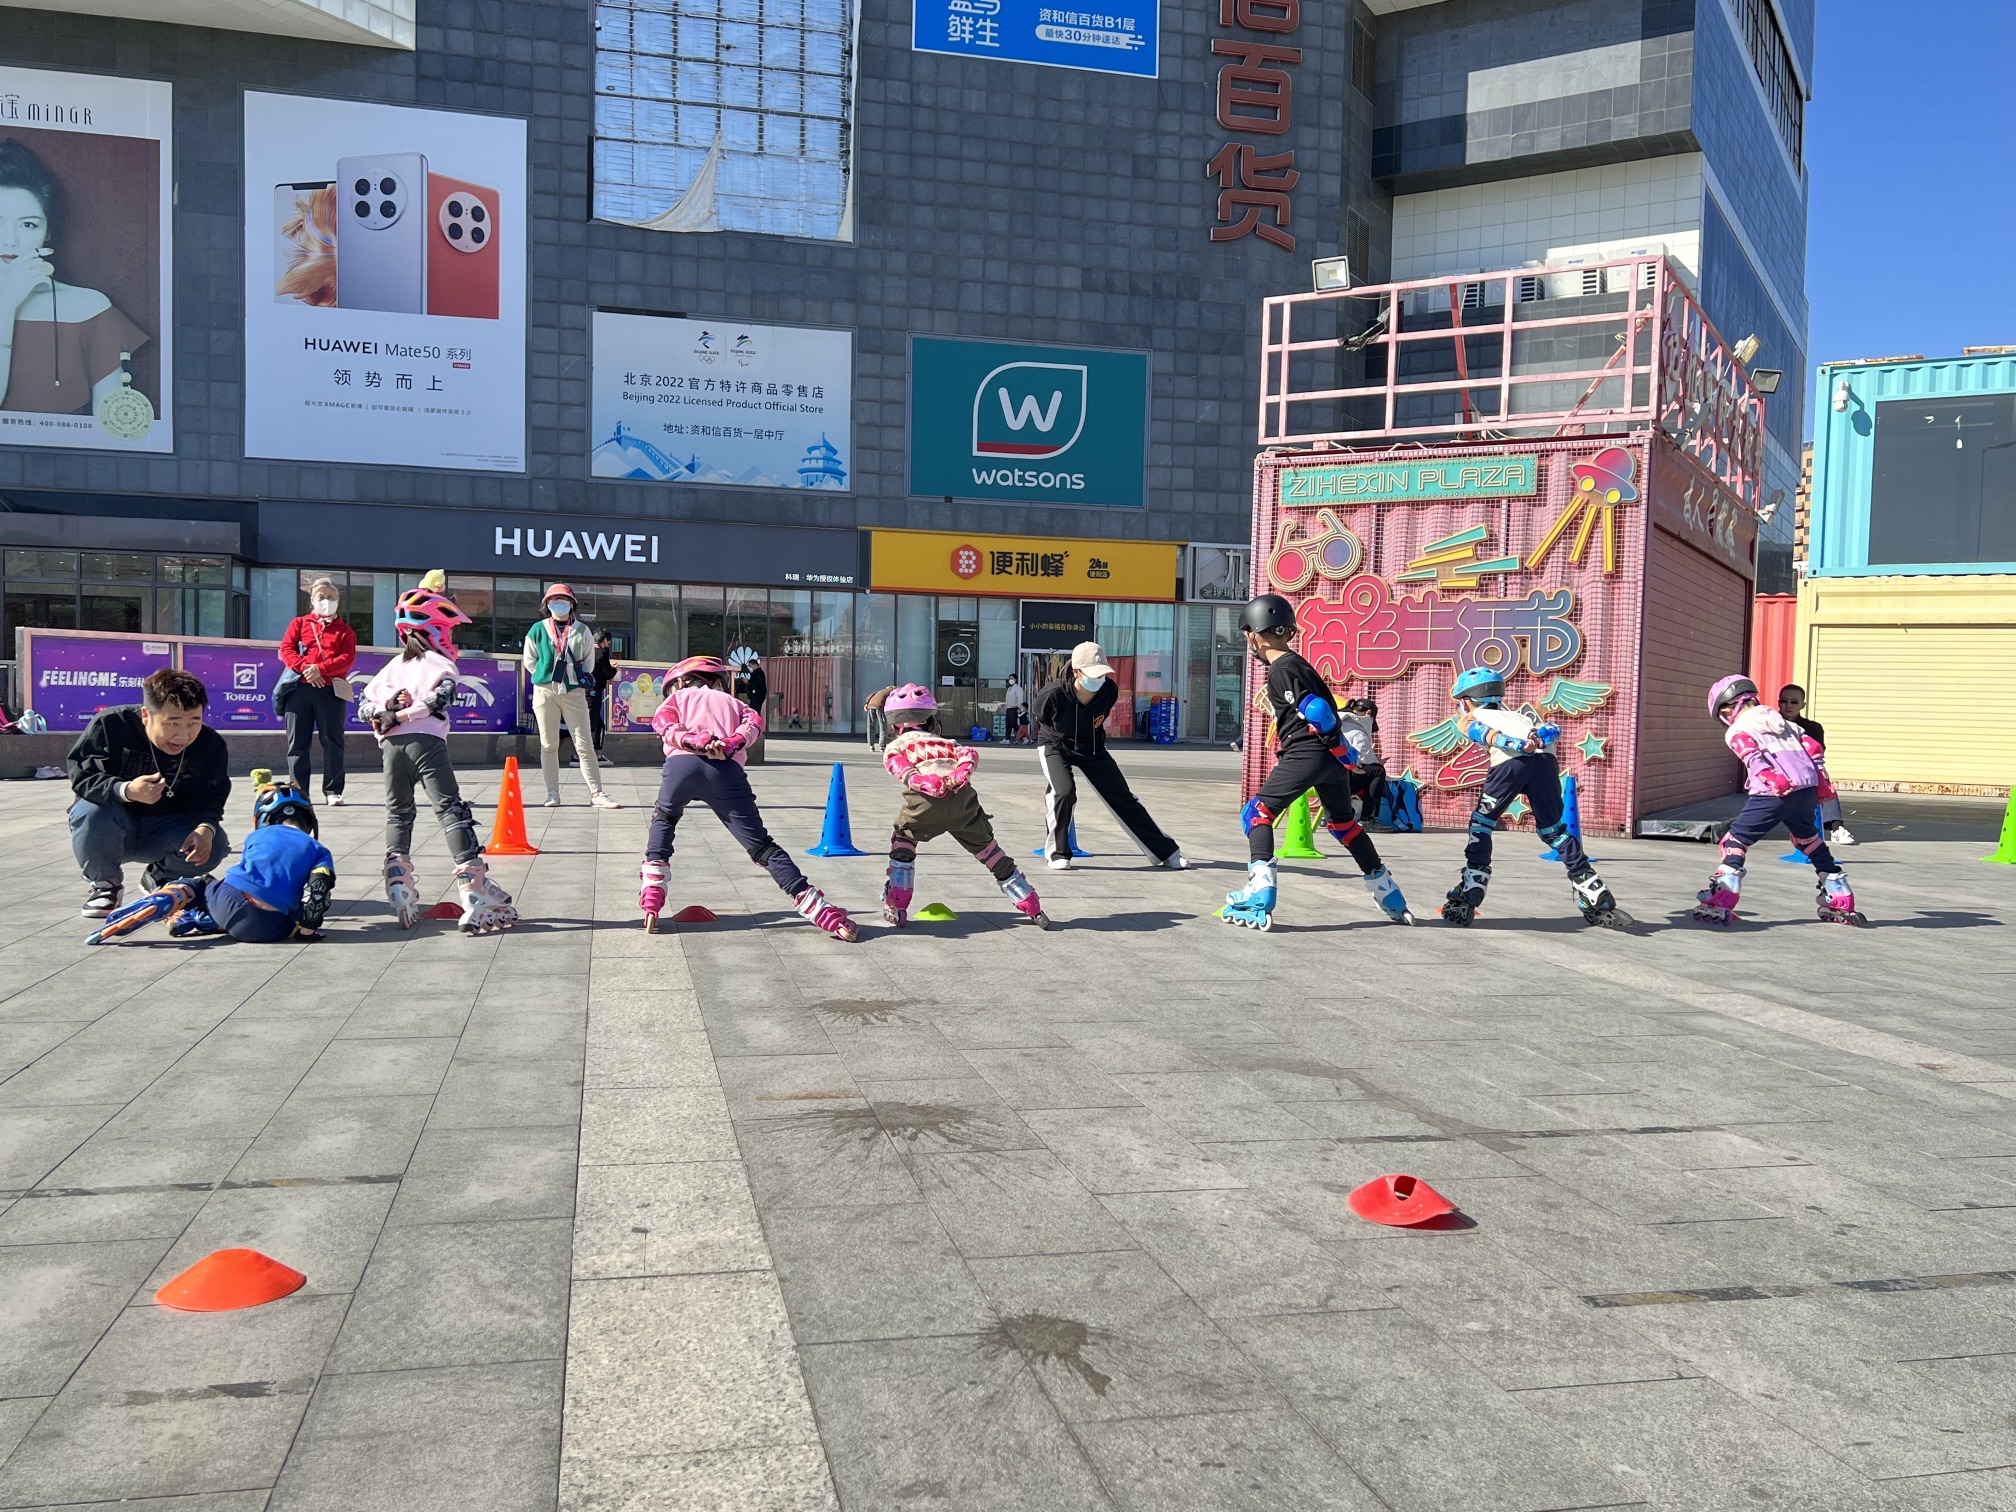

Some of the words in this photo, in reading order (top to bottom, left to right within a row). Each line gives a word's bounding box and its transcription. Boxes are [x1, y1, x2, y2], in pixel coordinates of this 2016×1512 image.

[947, 14, 1000, 47] 鲜生
[1039, 8, 1136, 31] 资和信百货B1层
[1045, 29, 1121, 46] 最快30分钟送达
[304, 337, 378, 355] HUAWEI
[385, 343, 441, 359] Mate50
[446, 348, 472, 361] 系列
[333, 368, 444, 391] 领势而上
[622, 391, 655, 404] Beijing
[657, 394, 681, 404] 2022
[683, 396, 723, 407] Licensed
[726, 399, 762, 410] Product
[764, 401, 797, 412] Official
[799, 404, 824, 414] Store
[972, 468, 1085, 489] watsons
[1289, 470, 1409, 497] ZIHEXIN
[1417, 465, 1526, 491] PLAZA
[495, 526, 659, 563] HUAWEI
[989, 551, 1067, 577] 便利蜂
[41, 670, 118, 687] FEELINGME
[223, 691, 267, 702] TOREAD
